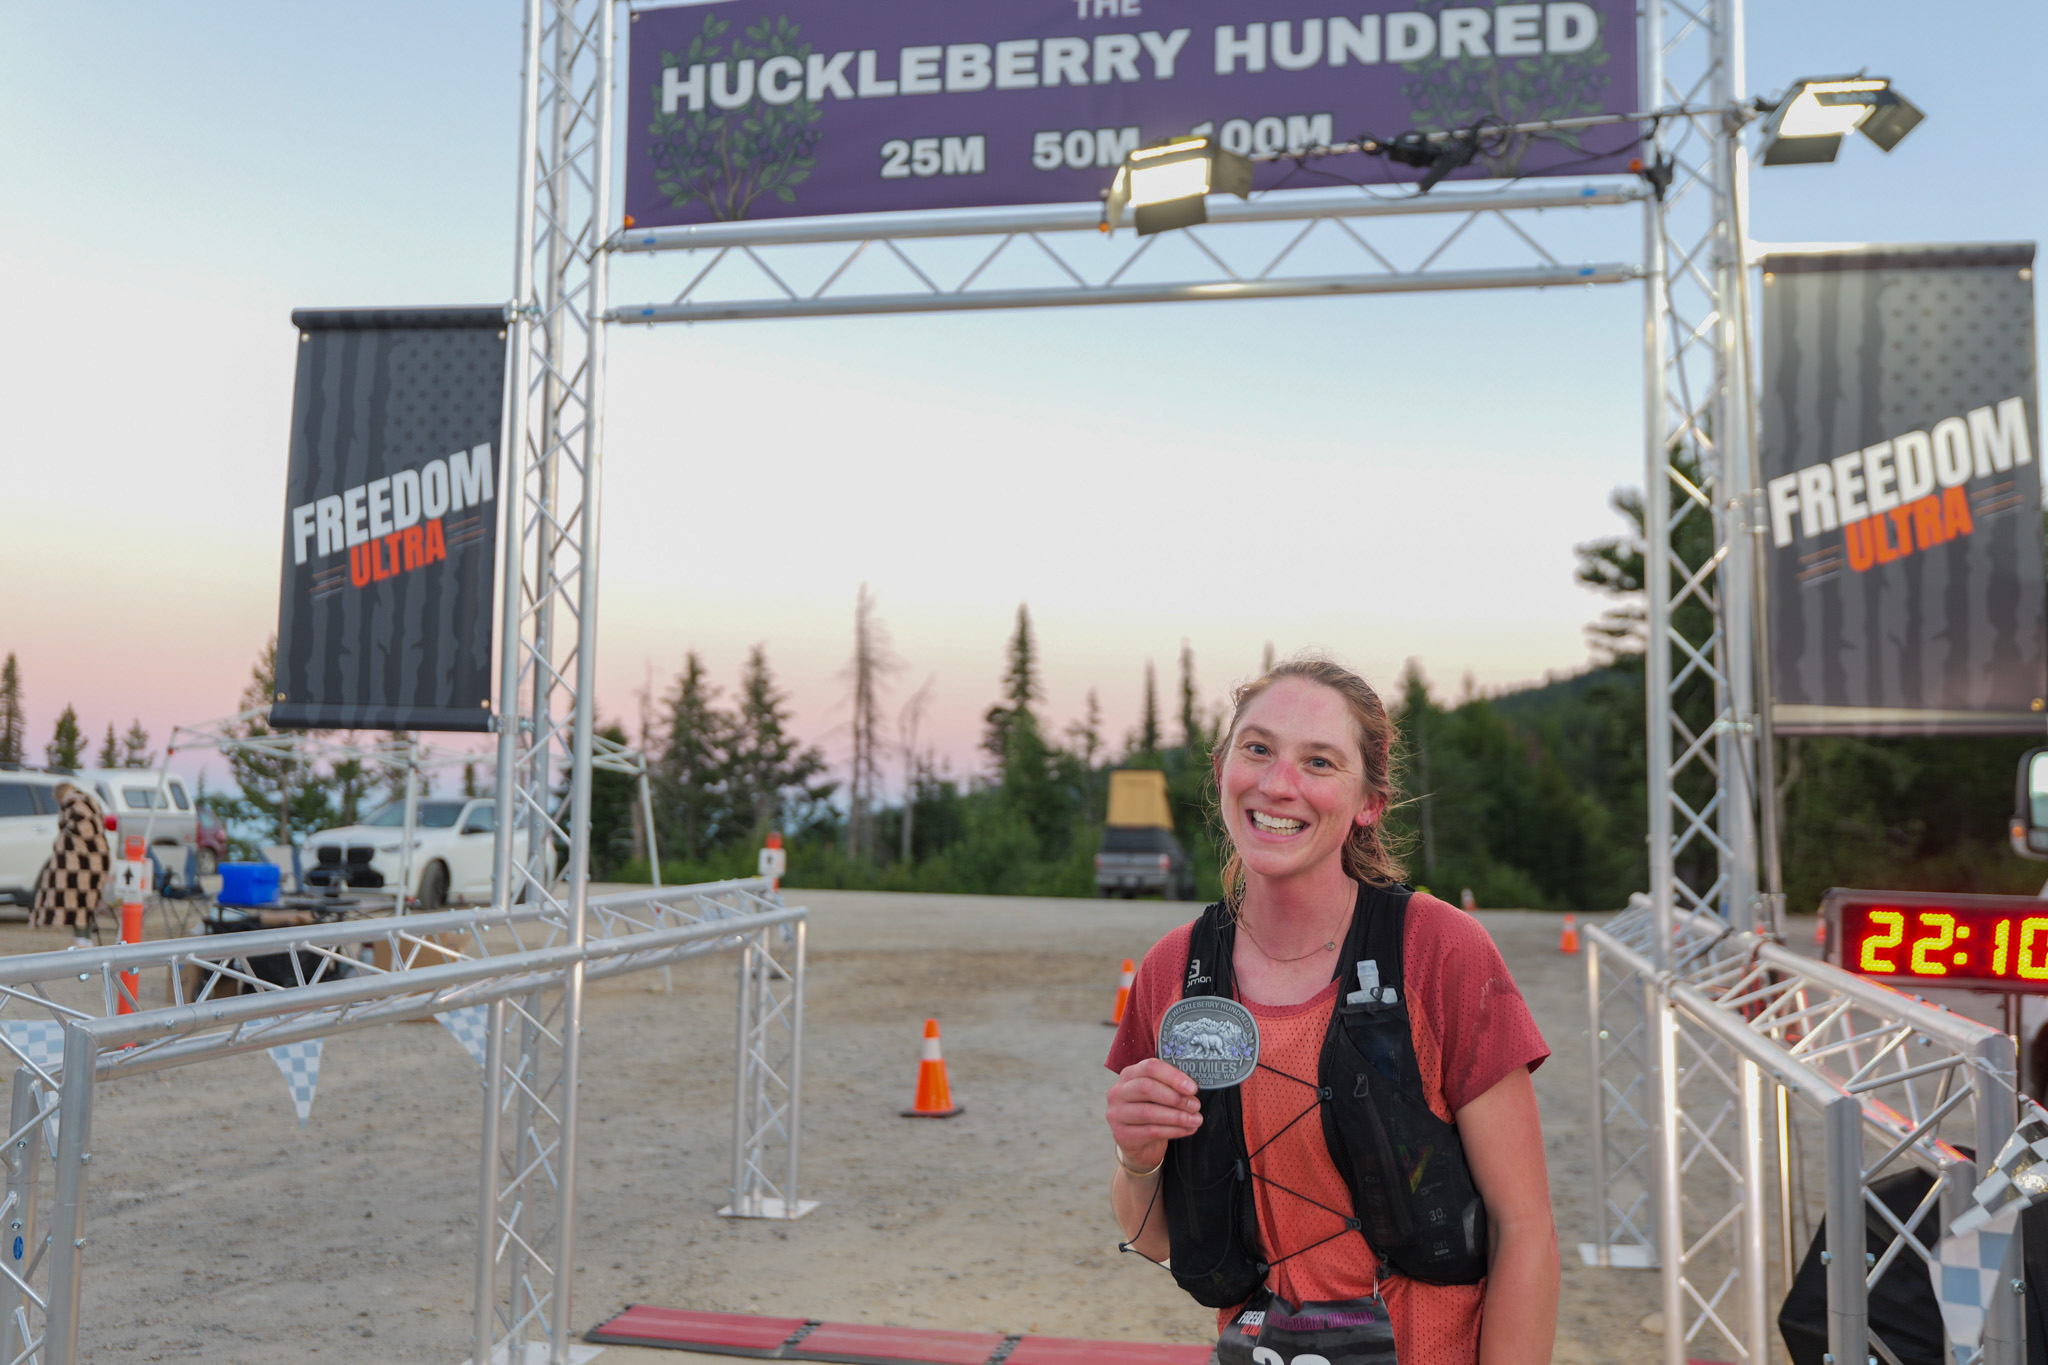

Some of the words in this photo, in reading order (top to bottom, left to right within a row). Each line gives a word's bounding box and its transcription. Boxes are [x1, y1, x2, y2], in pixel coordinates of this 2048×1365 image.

[1071, 0, 1142, 20] THE
[660, 27, 1192, 115] HUCKLEBERRY
[1214, 2, 1600, 76] HUNDRED
[880, 135, 987, 180] 25M
[1032, 126, 1142, 172] 50M
[291, 441, 495, 567] FREEDOM
[1767, 396, 2034, 549] FREEDOM
[349, 517, 447, 589] ULTRA
[1843, 485, 1974, 573] ULTRA
[1860, 910, 2048, 979] 22:10
[1165, 1015, 1174, 1030] THE
[1172, 1001, 1220, 1018] HUCKLEBERRY
[1220, 1002, 1251, 1028] HUNDRED
[1177, 1061, 1196, 1072] 100
[1198, 1061, 1238, 1074] MILES
